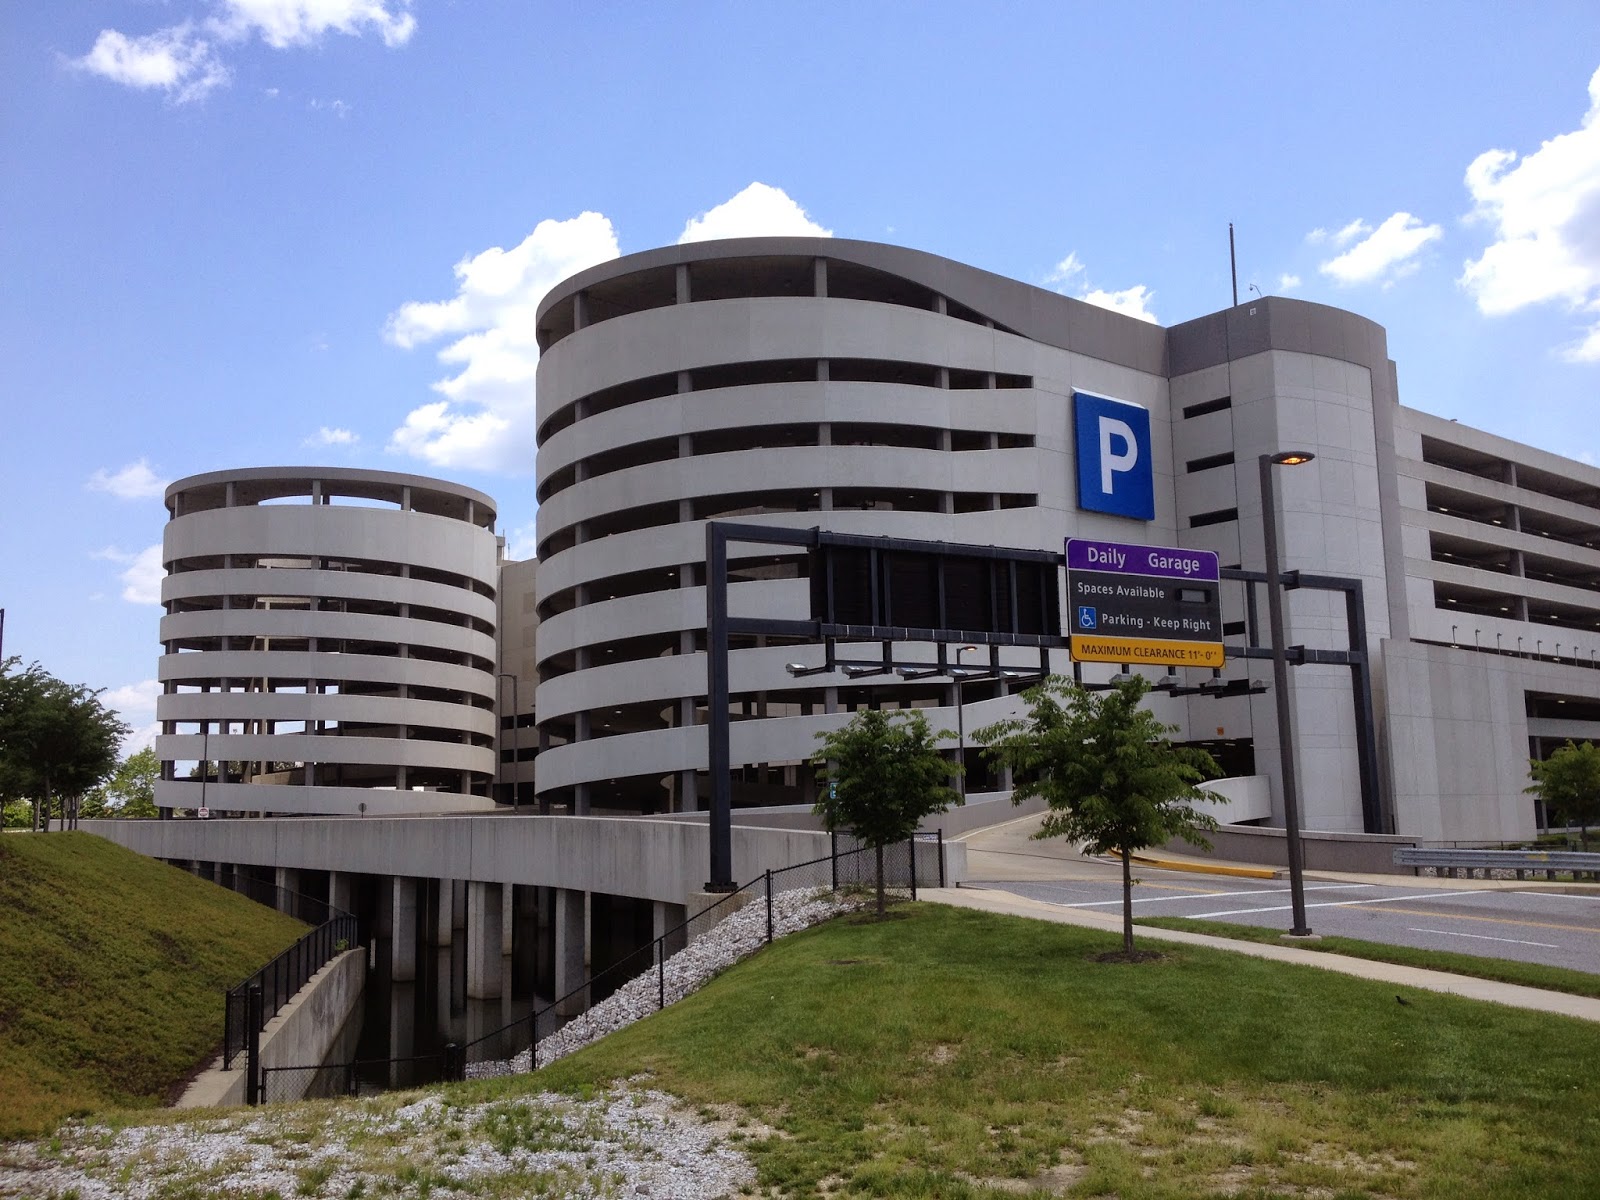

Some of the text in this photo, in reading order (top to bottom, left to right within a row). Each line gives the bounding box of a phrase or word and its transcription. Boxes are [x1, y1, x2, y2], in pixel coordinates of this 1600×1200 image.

[1099, 416, 1138, 494] P
[1087, 547, 1200, 575] Daily Garage
[1077, 581, 1165, 599] Spaces Available
[1102, 613, 1144, 629] Parking
[1153, 616, 1180, 630] Keep
[1182, 618, 1211, 632] Right
[1081, 644, 1131, 656] MAXIMUM
[1133, 646, 1186, 659] CLEARANCE
